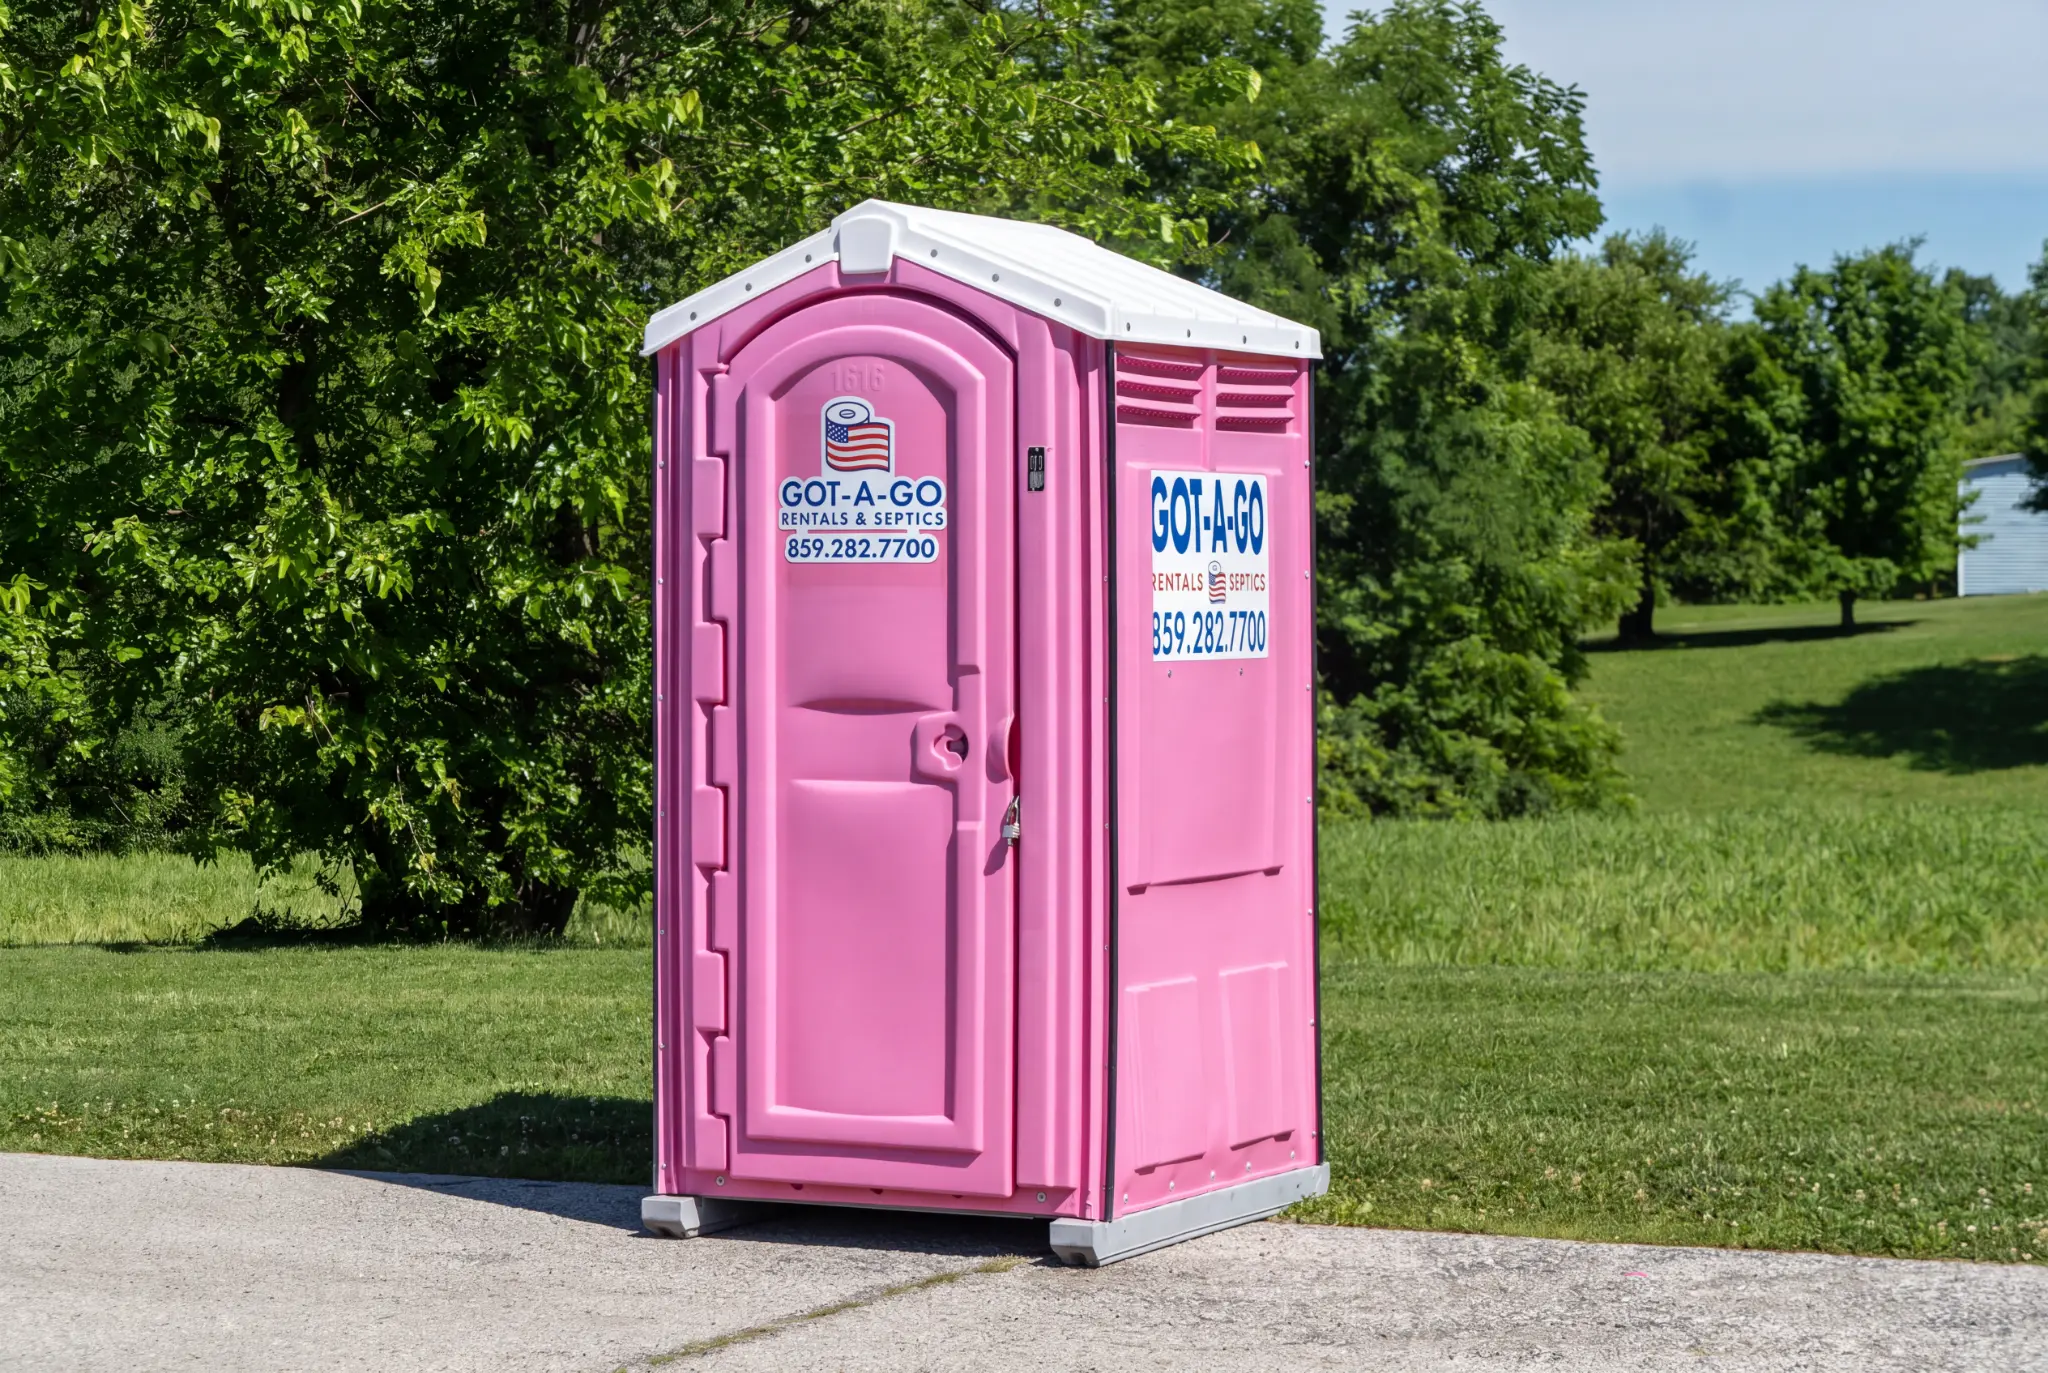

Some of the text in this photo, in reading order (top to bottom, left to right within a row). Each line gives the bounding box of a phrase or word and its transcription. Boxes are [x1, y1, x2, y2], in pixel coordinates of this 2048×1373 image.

[782, 480, 943, 507] GOT-A-GO
[782, 512, 944, 525] RENTALS & SEPTICS
[1151, 476, 1264, 555] GOT-A-GO
[787, 538, 936, 558] 859.282.7700
[1152, 573, 1266, 591] RENTALS SEPTICS
[1153, 610, 1266, 655] 859.282.7700
